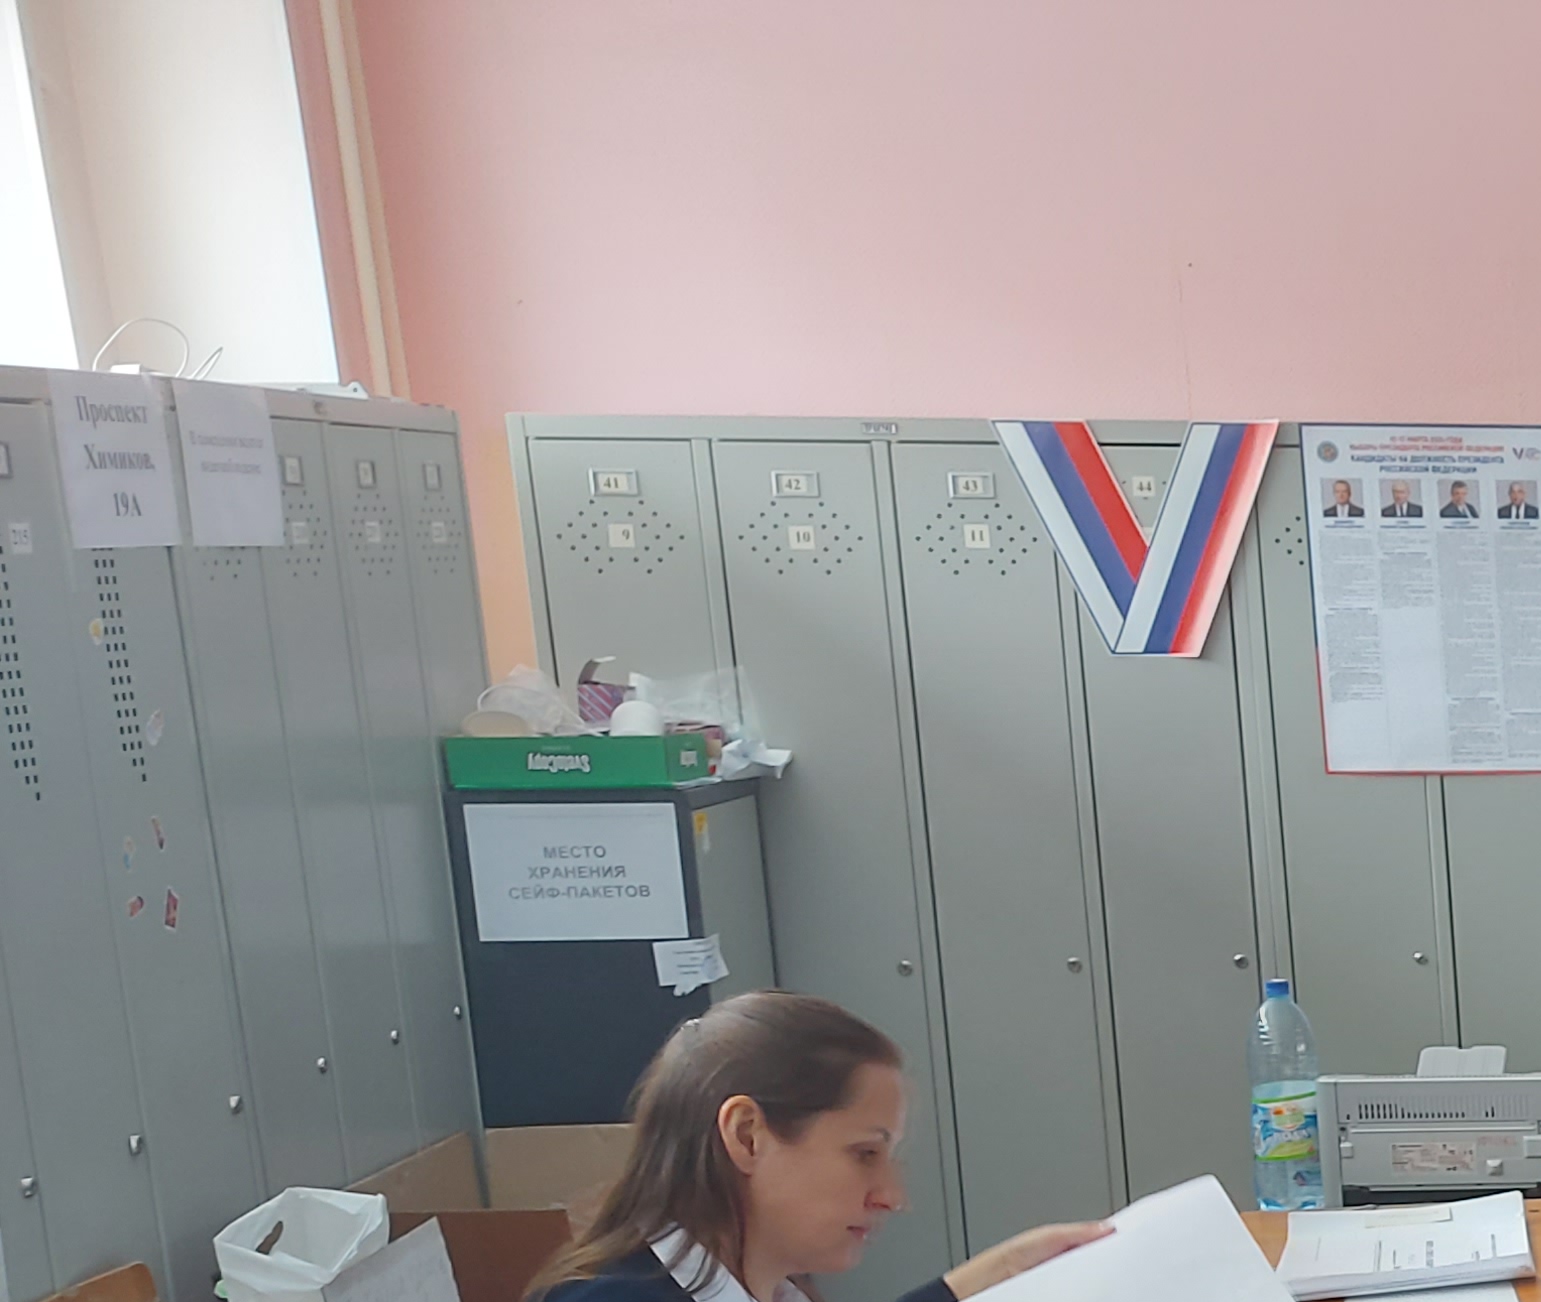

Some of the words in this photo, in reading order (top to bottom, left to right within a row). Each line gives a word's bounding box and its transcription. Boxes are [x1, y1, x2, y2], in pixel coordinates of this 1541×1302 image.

[73, 394, 150, 429] Проспект
[83, 443, 156, 471] Химиков,
[602, 476, 620, 490] 41
[784, 478, 802, 491] 42
[961, 479, 978, 492] 43
[1136, 480, 1153, 493] 44
[112, 491, 143, 518] 19А
[621, 528, 631, 541] 9
[795, 531, 811, 543] 10
[969, 530, 985, 542] 11
[542, 845, 607, 859] МЕСТО
[527, 865, 627, 880] ХРАНЕНИЯ
[508, 884, 651, 900] СЕЙФ-ПАКЕТОВ
